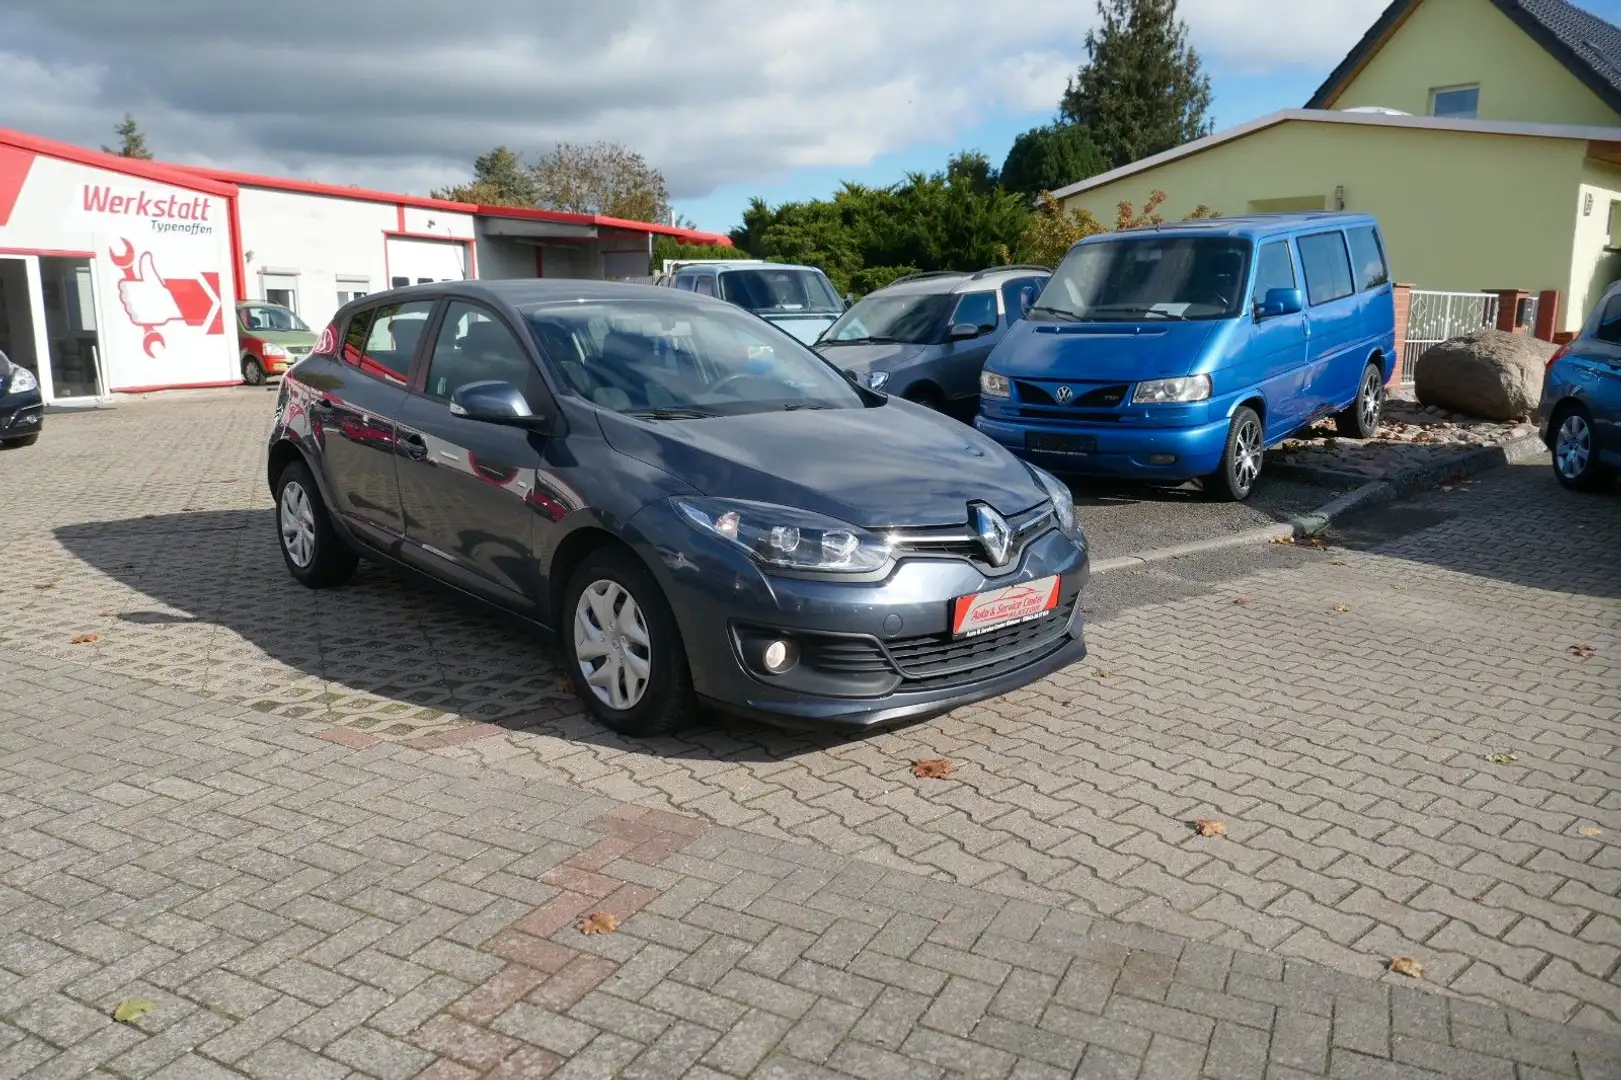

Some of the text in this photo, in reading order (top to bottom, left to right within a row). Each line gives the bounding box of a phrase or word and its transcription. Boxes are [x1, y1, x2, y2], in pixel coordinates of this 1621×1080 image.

[83, 184, 211, 221] Werkstatt
[151, 219, 213, 235] Typenoffen
[971, 608, 990, 620] Auto
[996, 602, 1022, 614] Service
[1023, 595, 1044, 607] Center
